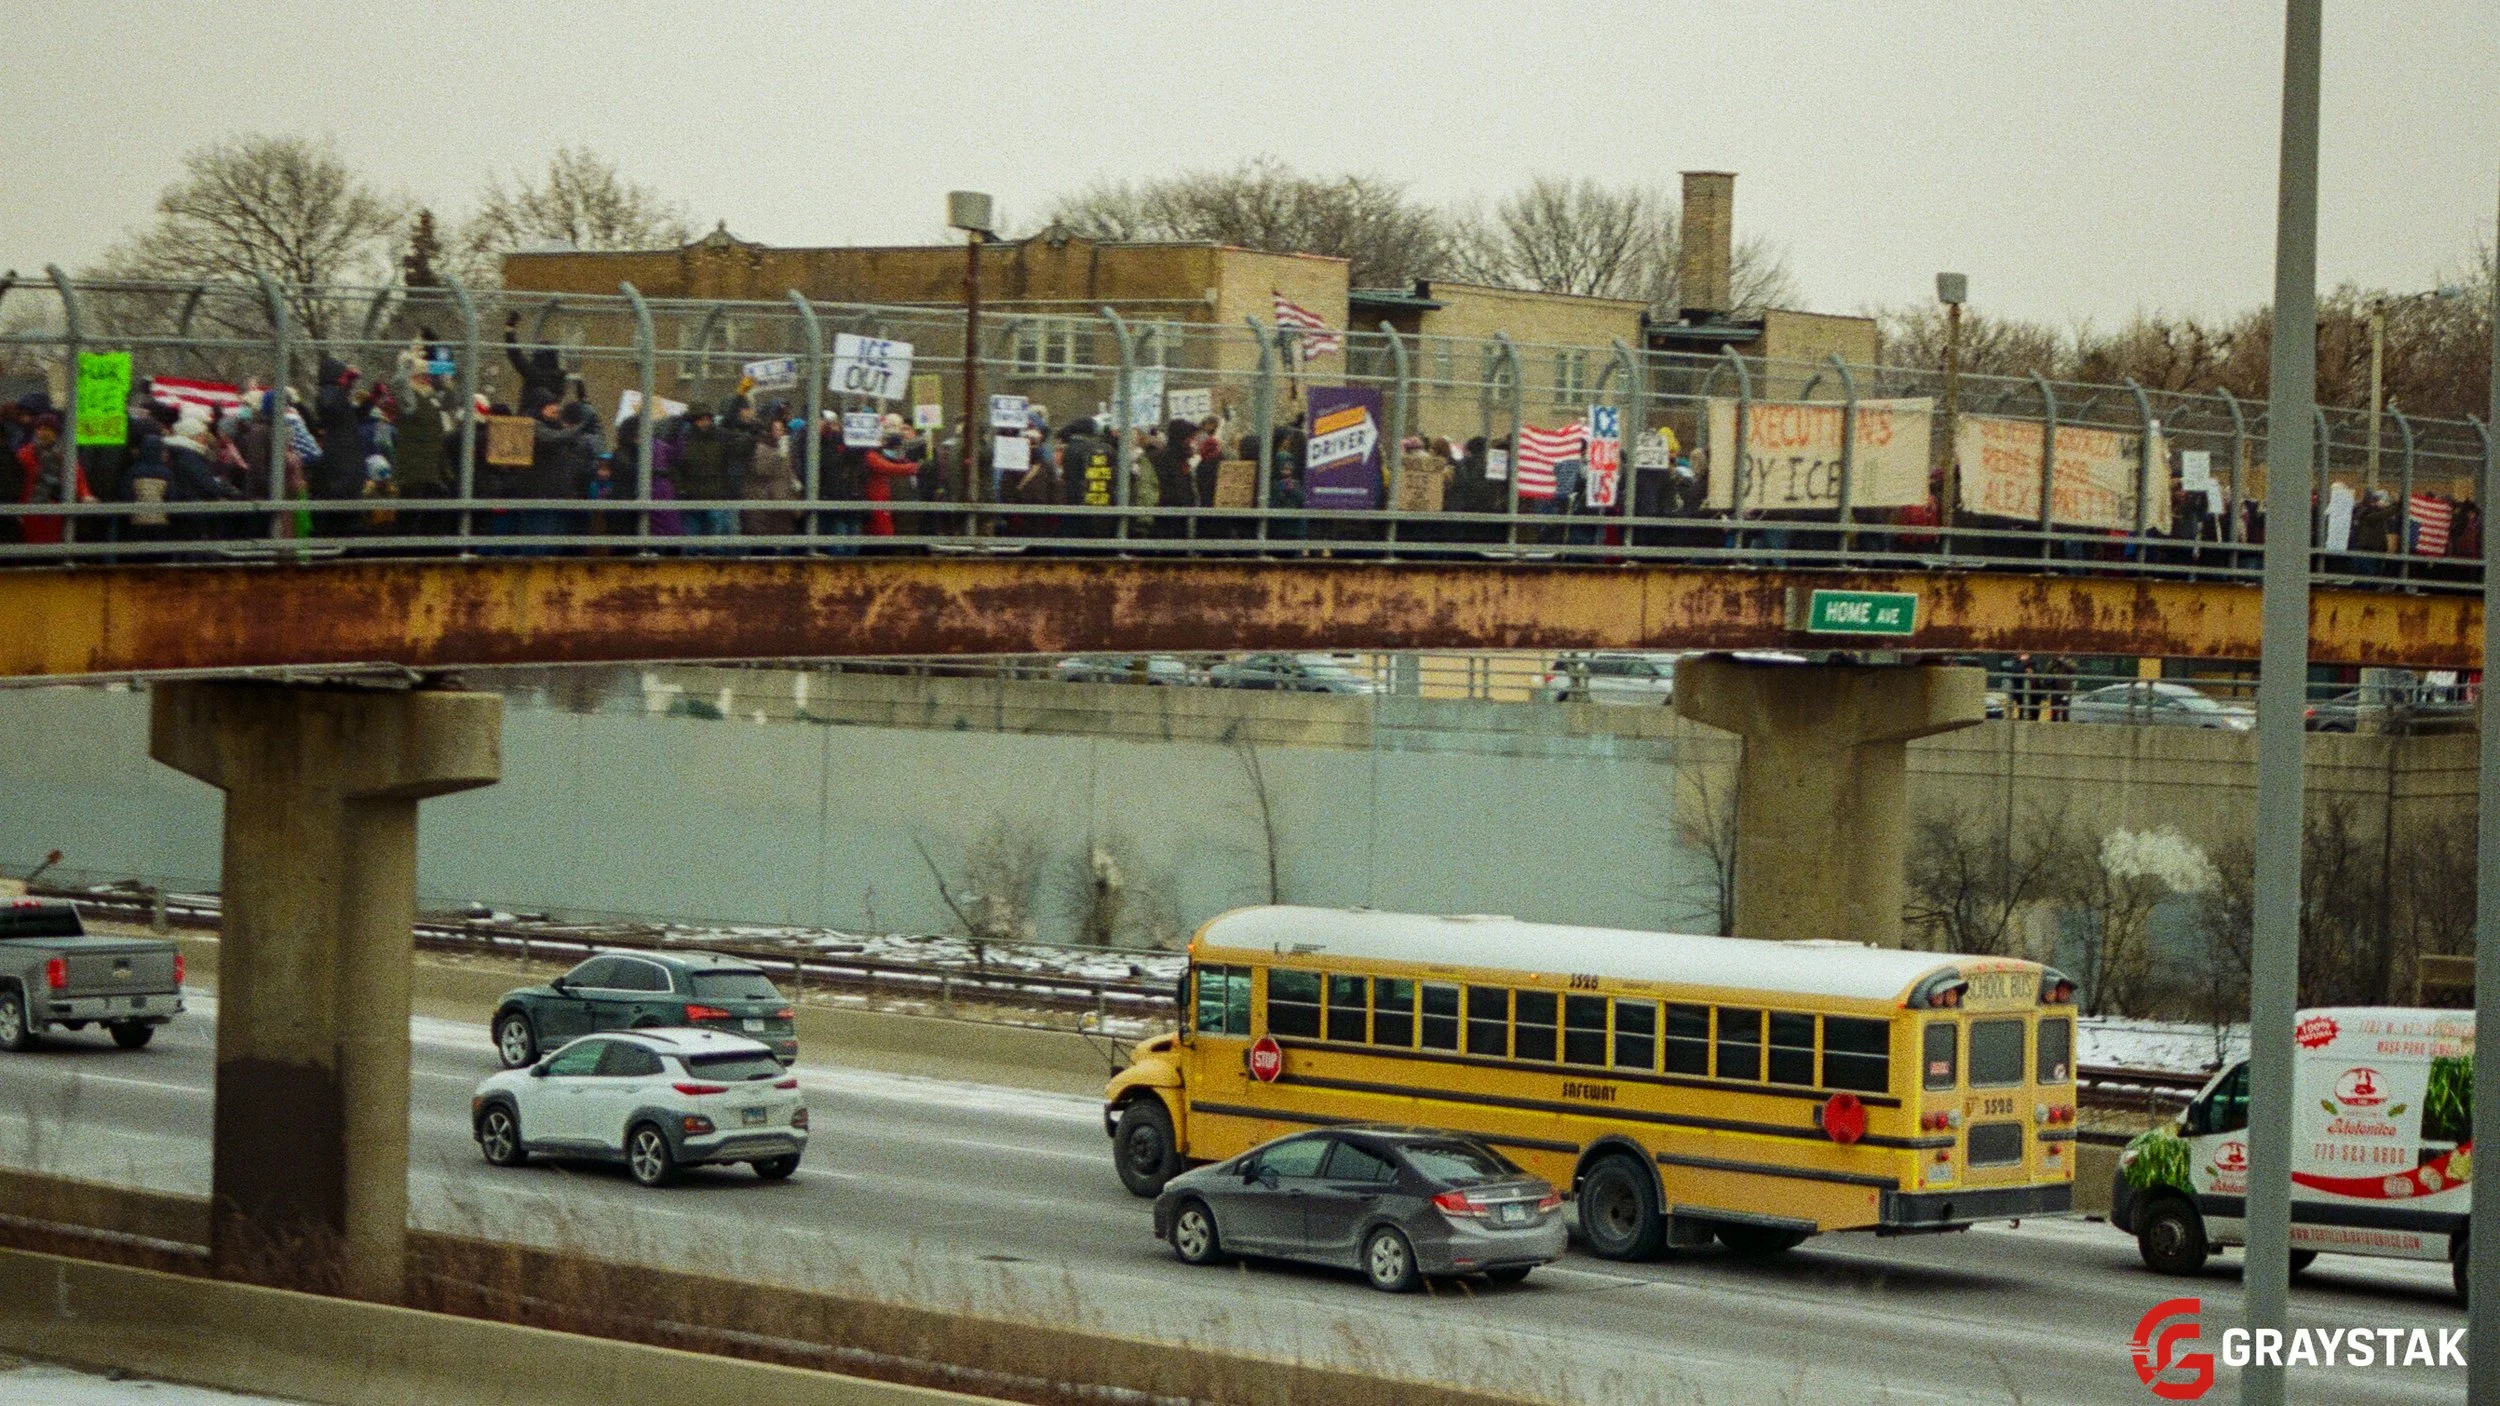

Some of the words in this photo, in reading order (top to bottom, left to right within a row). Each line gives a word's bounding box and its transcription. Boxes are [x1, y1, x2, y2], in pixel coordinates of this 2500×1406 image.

[858, 339, 893, 368] ICE
[845, 365, 893, 394] OUT
[1748, 405, 1894, 449] XECUTINS
[1310, 429, 1367, 460] DRIVER
[1784, 457, 1843, 504] ICE
[1825, 601, 1872, 623] HOME
[1875, 607, 1900, 625] AVE
[1968, 973, 2007, 1000] SCHOOL
[2011, 973, 2032, 998] BUS
[1255, 1051, 1277, 1069] STOP
[1562, 1082, 1617, 1101] SAFEWAY
